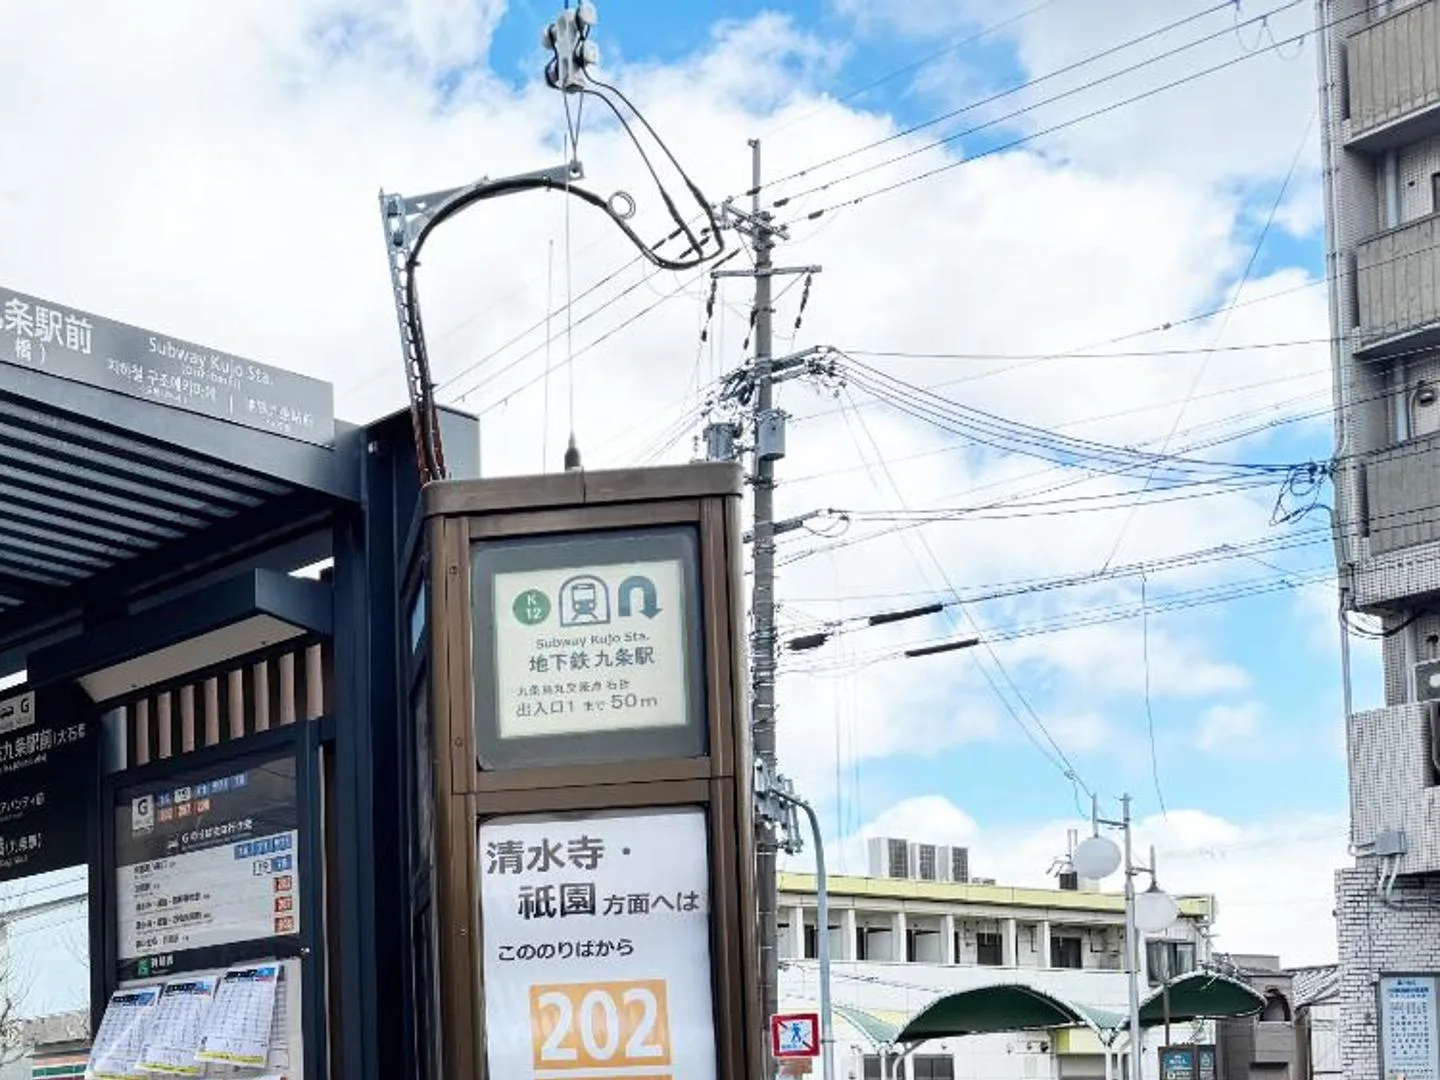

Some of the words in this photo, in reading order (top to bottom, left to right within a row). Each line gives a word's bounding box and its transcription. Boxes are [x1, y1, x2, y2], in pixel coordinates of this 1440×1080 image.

[148, 336, 207, 367] Subway
[210, 354, 243, 377] Kujo
[526, 595, 537, 606] K
[525, 608, 541, 620] 12
[536, 634, 586, 650] Subway
[590, 632, 621, 647] Kujo
[610, 694, 658, 710] 50m
[498, 938, 635, 962] こののりばから
[538, 987, 664, 1061] 202
